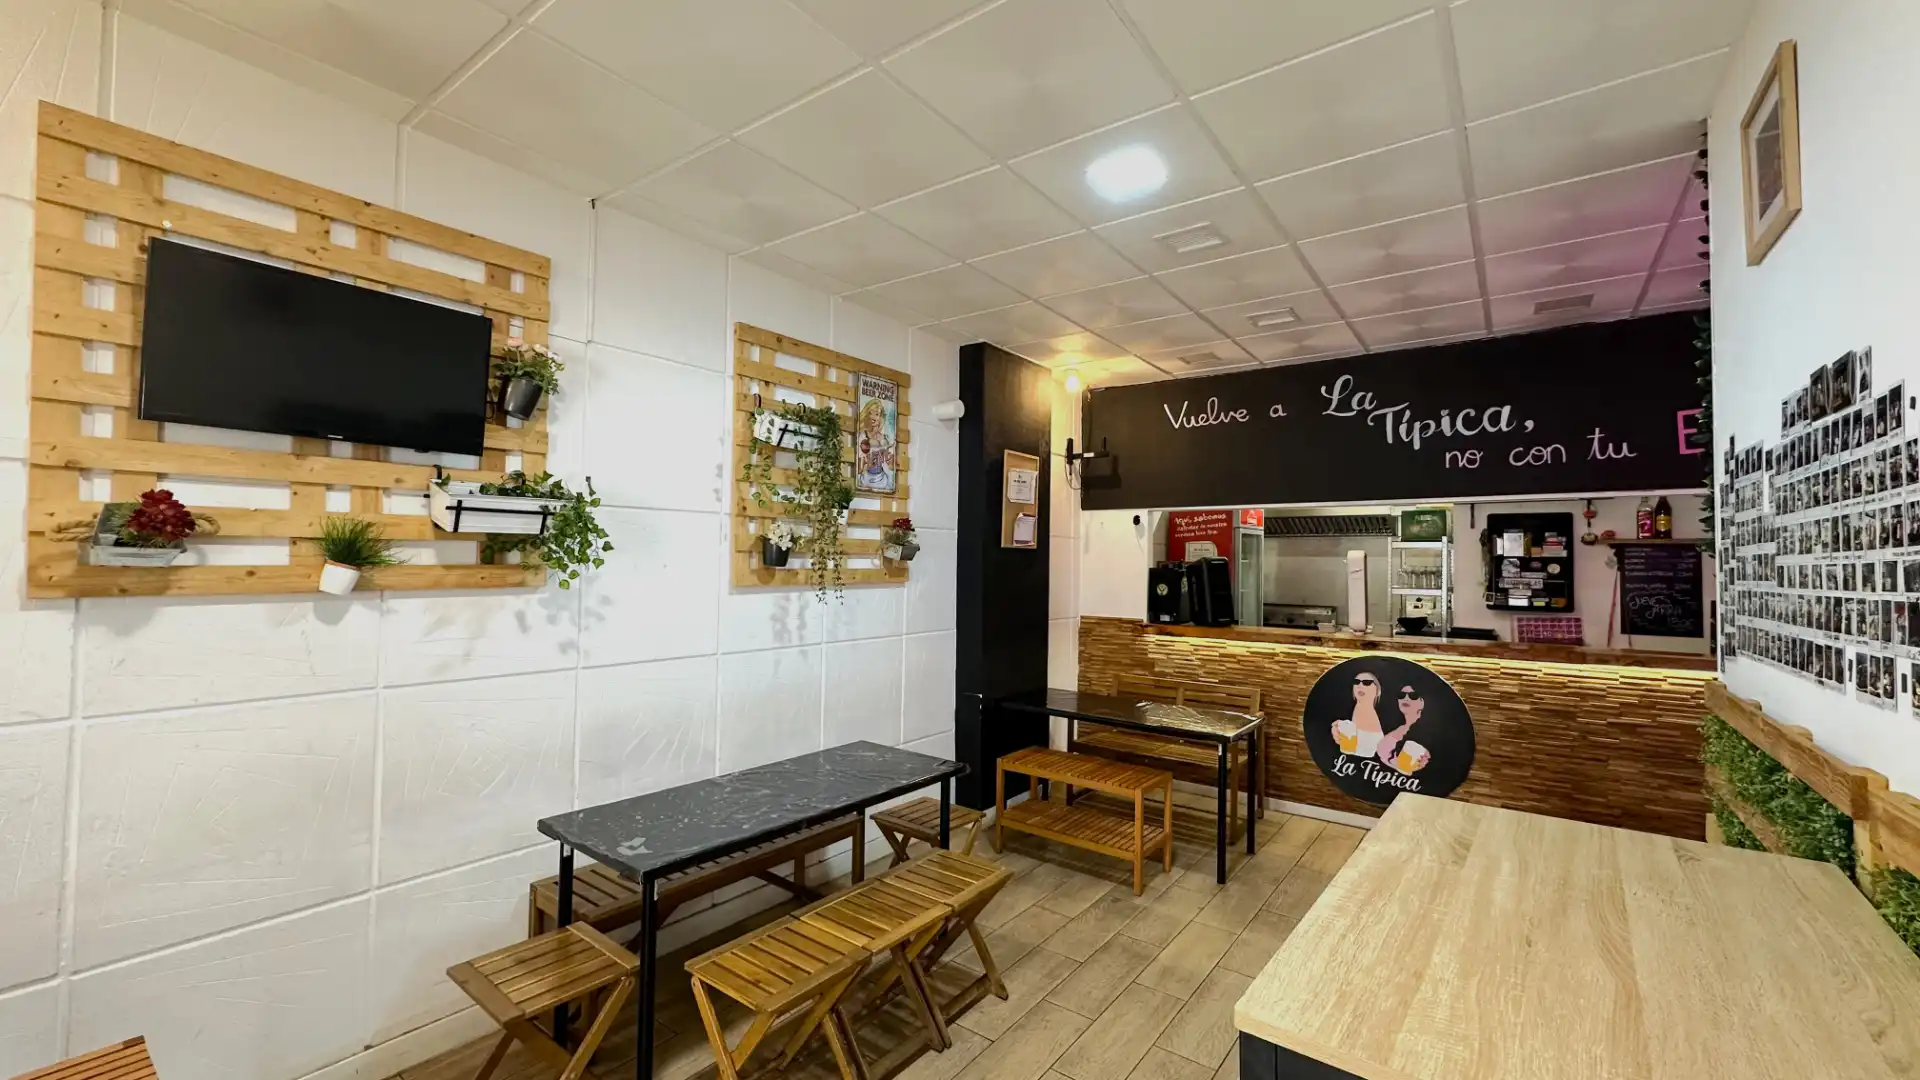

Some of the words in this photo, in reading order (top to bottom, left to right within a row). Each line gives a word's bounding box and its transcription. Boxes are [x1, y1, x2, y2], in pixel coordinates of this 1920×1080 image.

[862, 378, 894, 394] WARNING
[862, 387, 876, 397] BEER
[877, 391, 894, 402] ZONE
[1163, 397, 1249, 430] Vuelve
[1268, 404, 1287, 418] a
[1321, 374, 1377, 417] La
[1367, 400, 1535, 449] Típica,
[1445, 447, 1484, 469] no
[1509, 441, 1566, 467] con
[1587, 427, 1638, 462] tu
[1331, 754, 1356, 777] La
[1360, 759, 1422, 792] Típica
